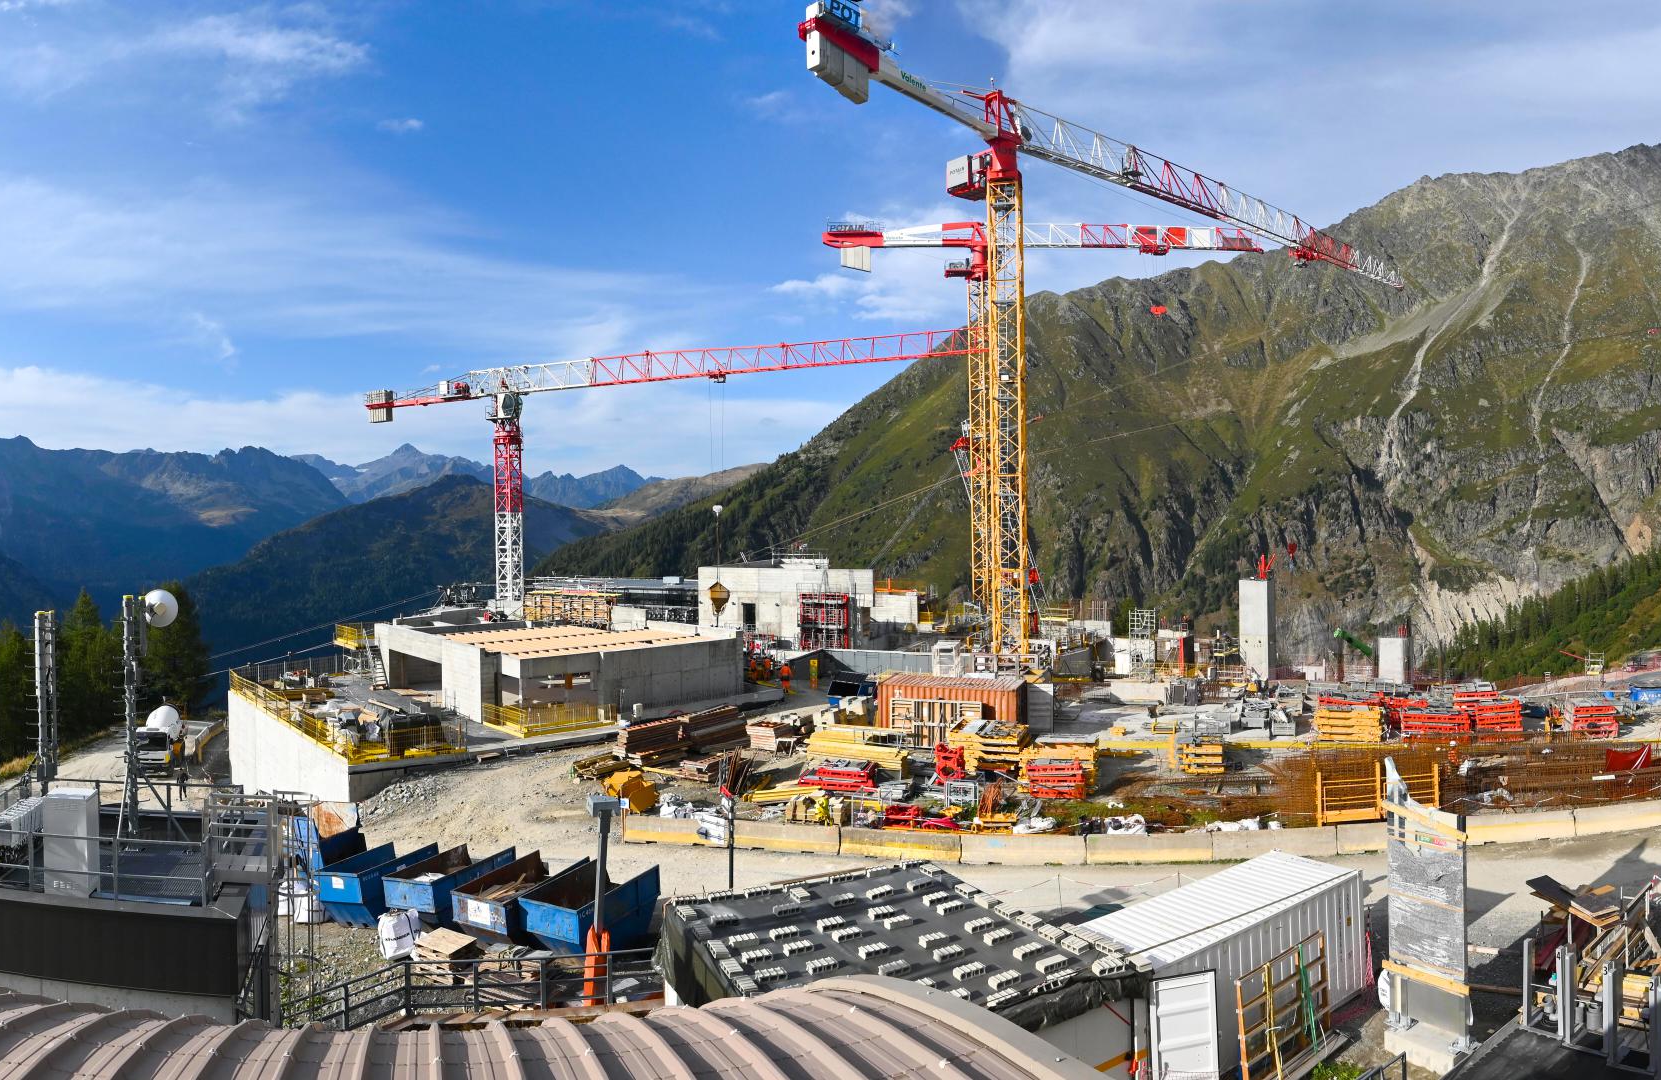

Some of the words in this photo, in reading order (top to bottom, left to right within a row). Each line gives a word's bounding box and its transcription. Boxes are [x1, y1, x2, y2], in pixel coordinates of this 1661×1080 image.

[900, 70, 927, 92] Valente
[829, 224, 865, 232] POTAIN
[1556, 952, 1561, 961] 4
[1603, 966, 1609, 976] 3
[1649, 981, 1655, 991] 2
